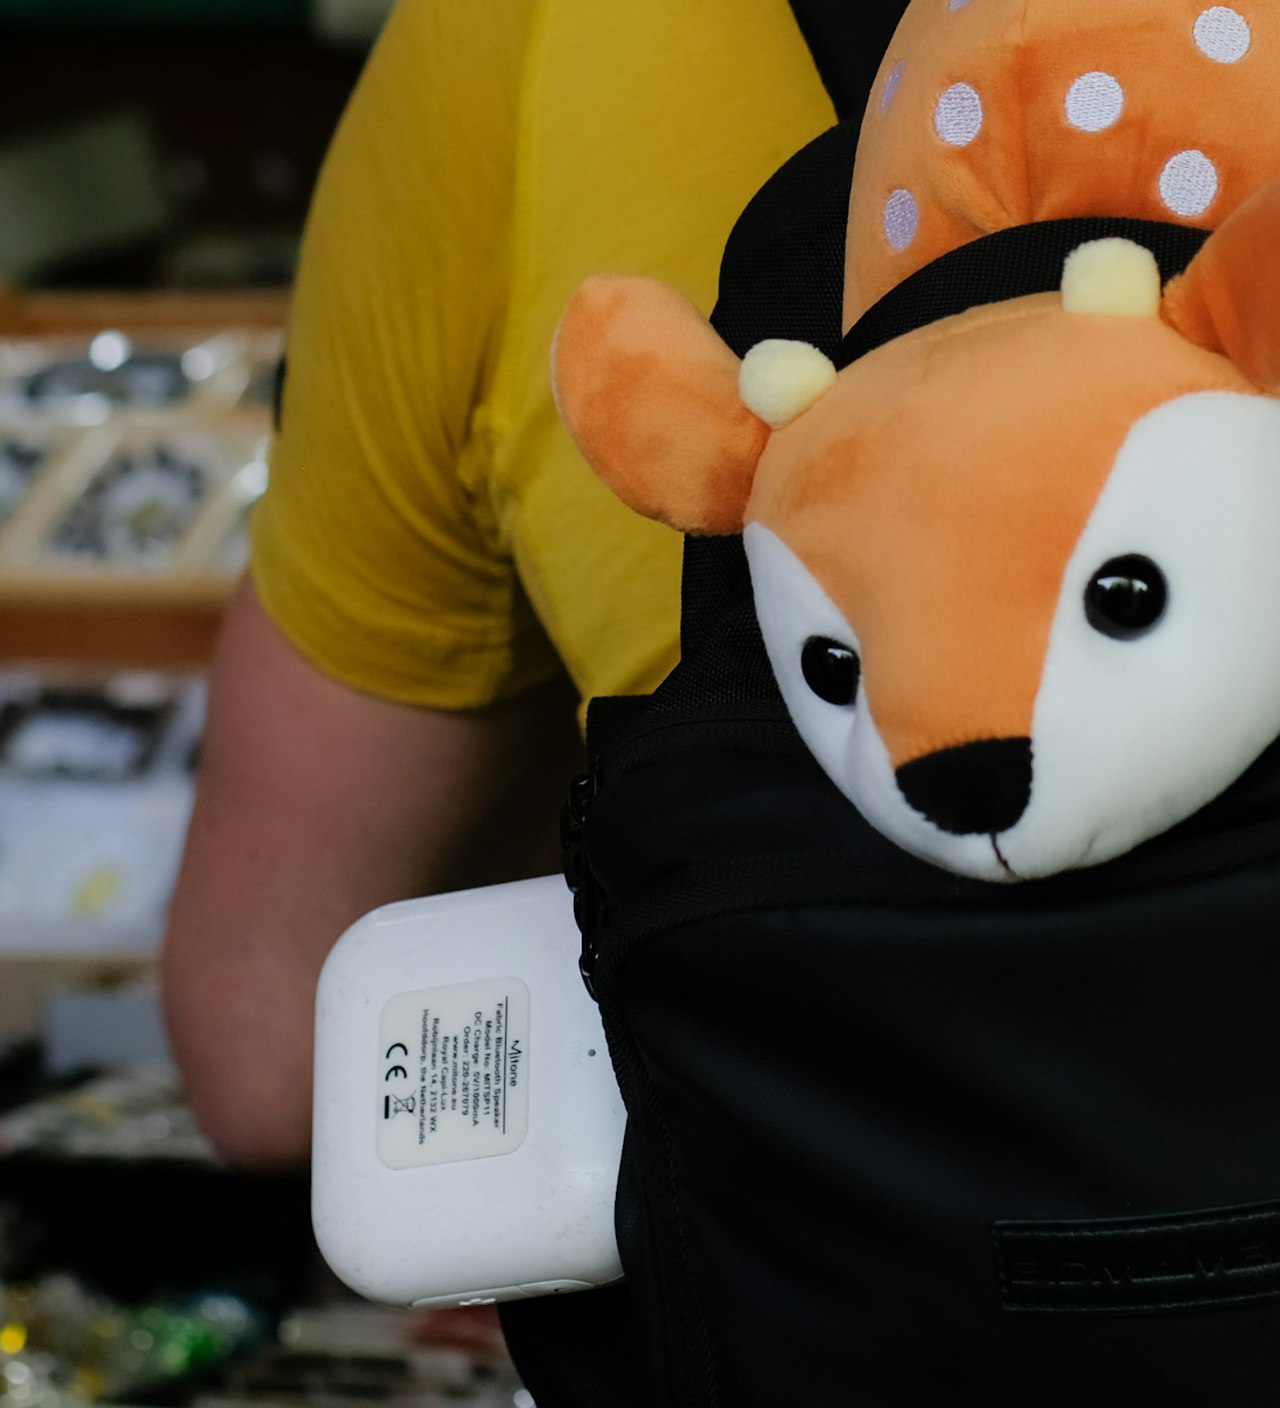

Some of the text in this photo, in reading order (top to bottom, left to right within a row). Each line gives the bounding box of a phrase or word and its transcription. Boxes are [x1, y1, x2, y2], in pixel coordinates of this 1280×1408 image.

[475, 1012, 482, 1025] DC
[441, 1036, 449, 1064] Royal
[494, 1037, 502, 1085] Bluetooth
[508, 1040, 522, 1086] Mitone
[430, 1116, 437, 1131] WX
[493, 1088, 501, 1128] Speaker
